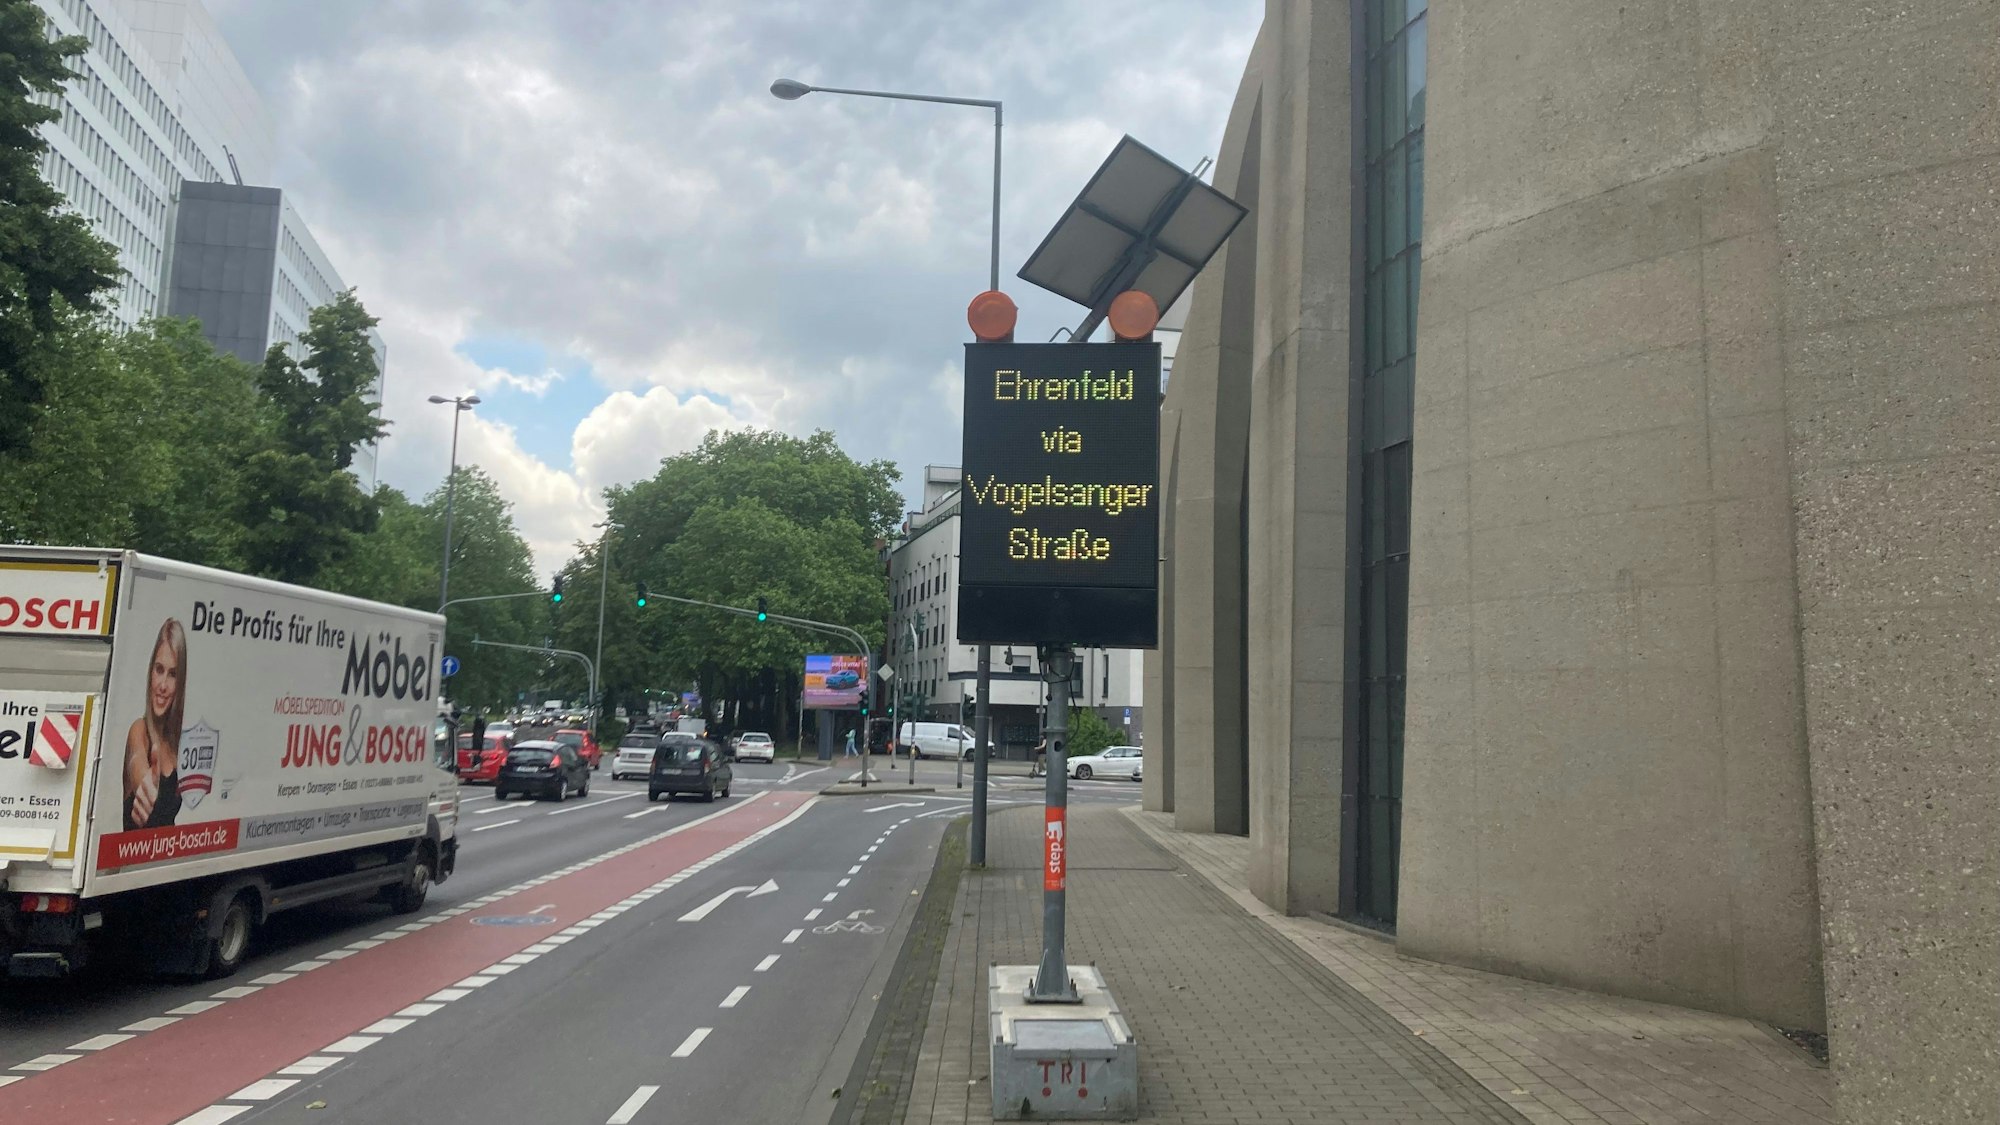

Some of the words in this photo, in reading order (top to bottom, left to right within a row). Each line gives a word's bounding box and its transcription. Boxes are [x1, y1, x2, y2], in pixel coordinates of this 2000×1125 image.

[994, 369, 1135, 401] Ehrenfeld
[1040, 425, 1083, 453] via
[966, 474, 1153, 516] Vogelsanger
[1008, 527, 1111, 560] Straße
[191, 601, 225, 635] Die
[230, 607, 283, 642] Profis
[288, 614, 313, 645] für
[315, 619, 345, 649] Ihre
[341, 631, 436, 701] Möbel
[2, 701, 38, 717] Ihre
[273, 691, 345, 716] MÖBELSPEDITION
[182, 748, 197, 769] 30
[281, 724, 342, 768] JUNG
[365, 725, 427, 764] BOSCH
[29, 795, 61, 806] Essen
[278, 784, 299, 798] Kerpen
[118, 826, 227, 859] www.jung-bosch.de
